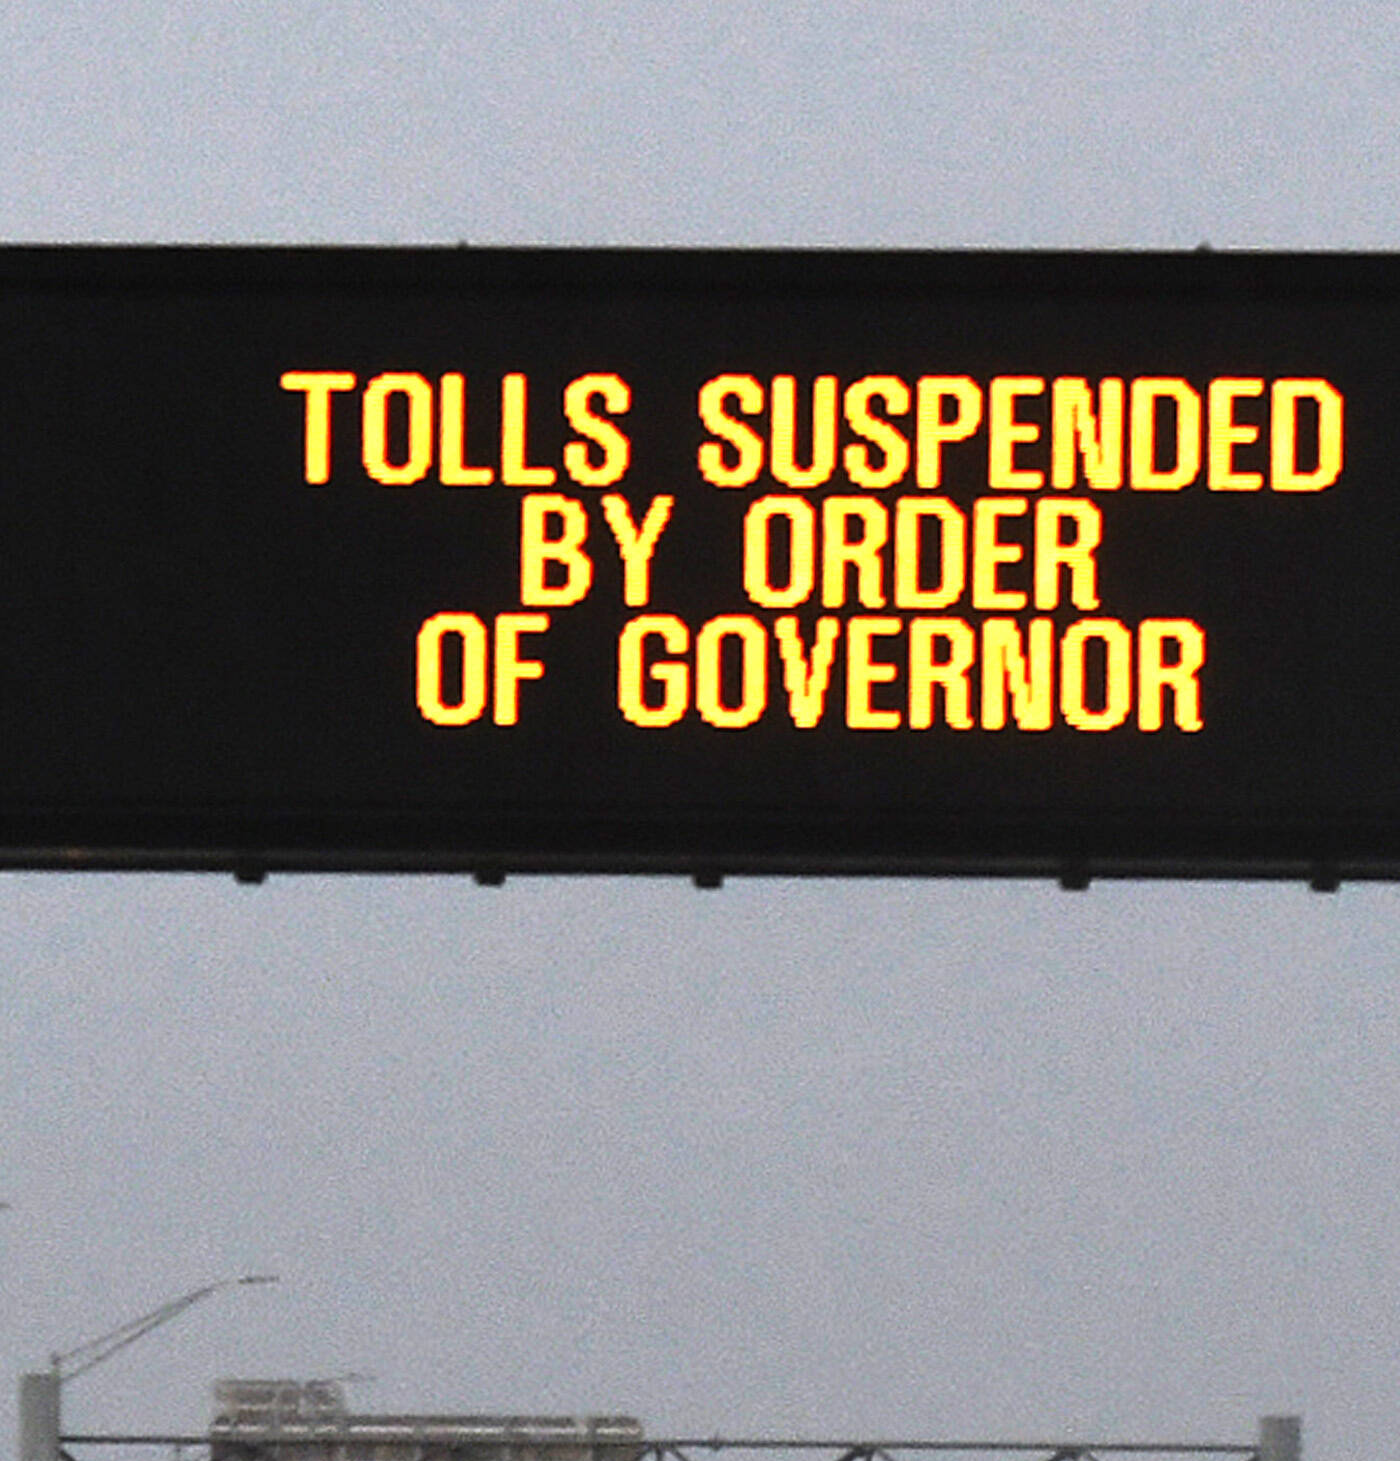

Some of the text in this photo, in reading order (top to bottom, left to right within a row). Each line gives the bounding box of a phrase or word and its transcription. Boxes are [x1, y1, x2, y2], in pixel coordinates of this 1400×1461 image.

[280, 370, 1345, 492] TOLLS SUSPENDED
[519, 493, 1104, 611] BY ORDER
[415, 612, 1207, 733] OF GOVERNOR
